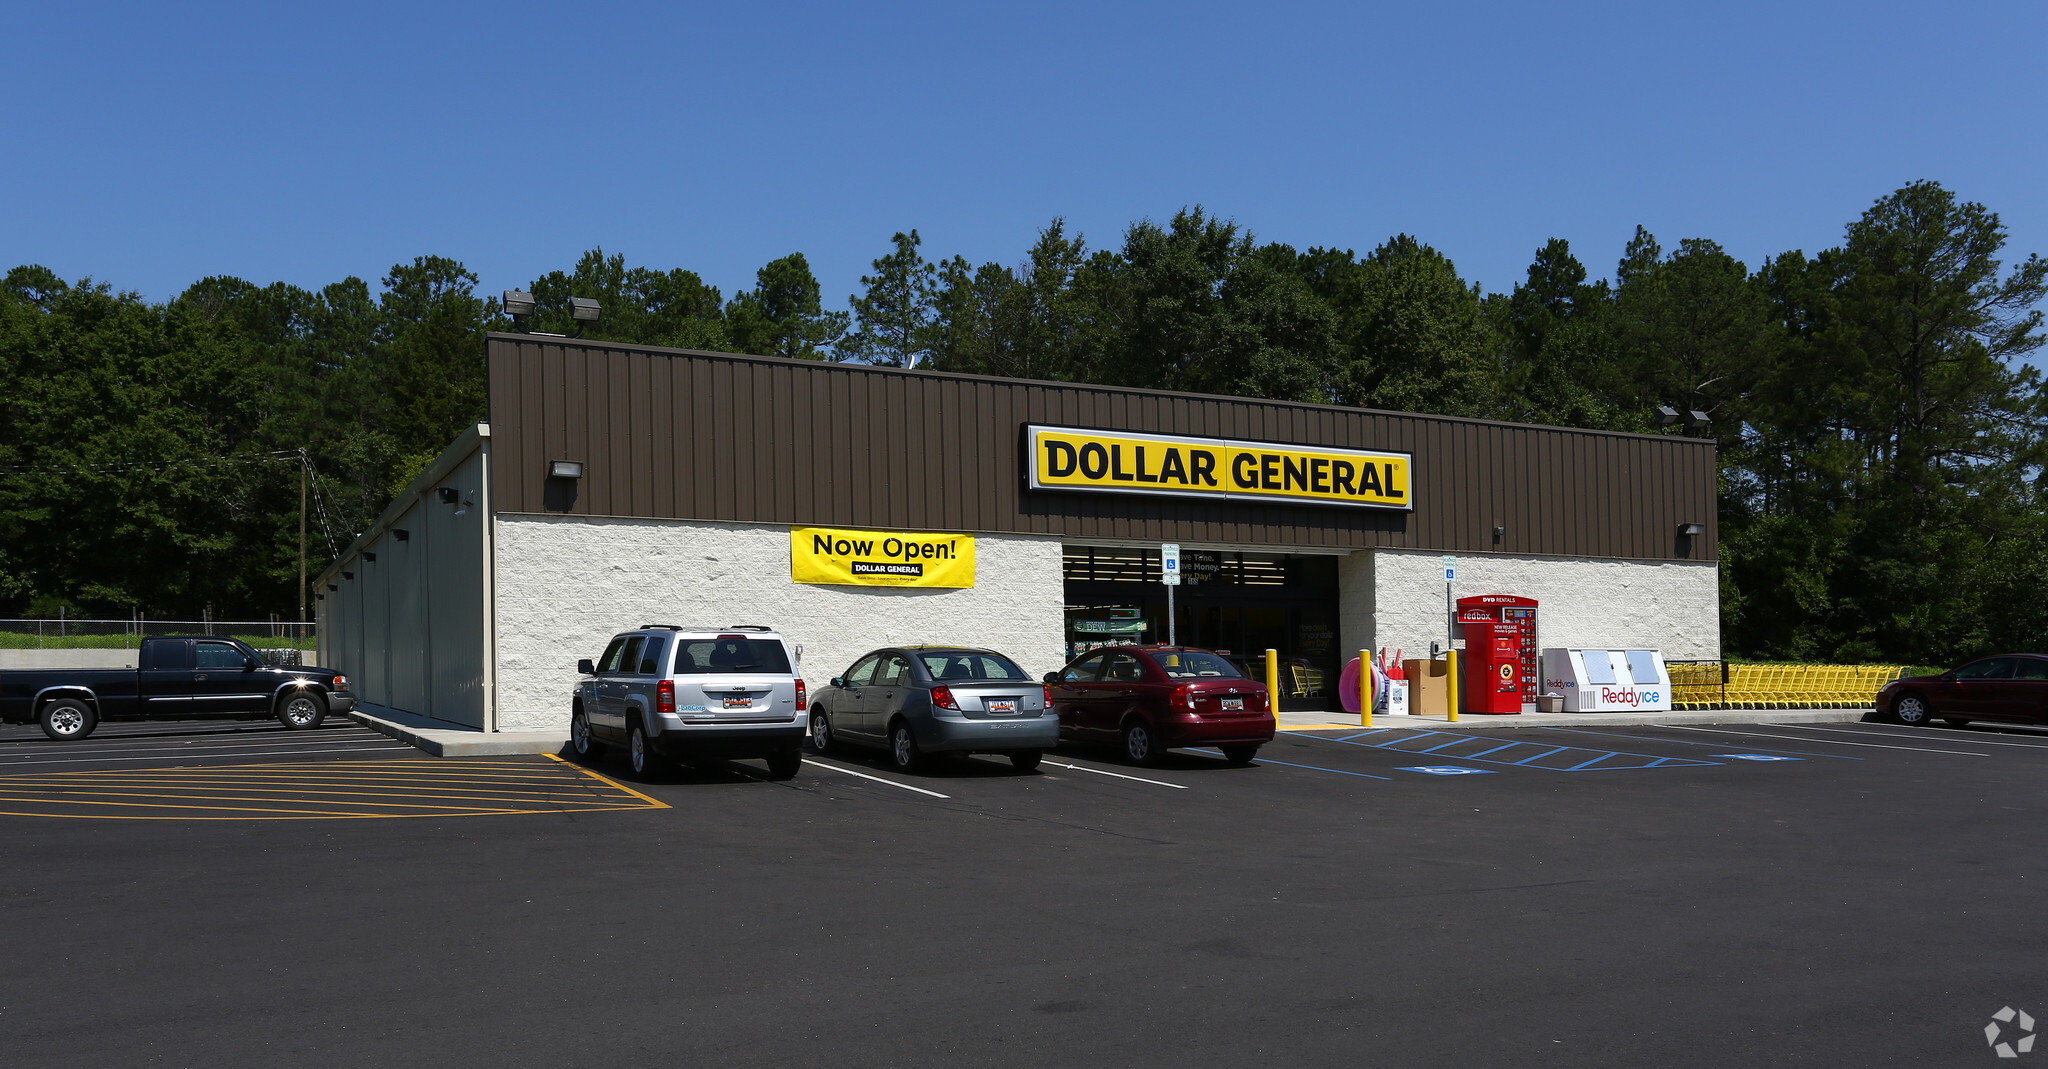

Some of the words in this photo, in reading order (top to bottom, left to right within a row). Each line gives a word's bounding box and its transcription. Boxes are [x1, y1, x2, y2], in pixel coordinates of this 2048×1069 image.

[1044, 440, 1218, 486] DOLLAR
[1232, 452, 1404, 498] GENERAL
[814, 534, 874, 556] Now
[883, 538, 956, 562] Open!
[855, 564, 886, 572] DOLLAR
[887, 566, 920, 574] GENERAL
[1194, 563, 1219, 572] Money.
[1464, 612, 1491, 620] redbox
